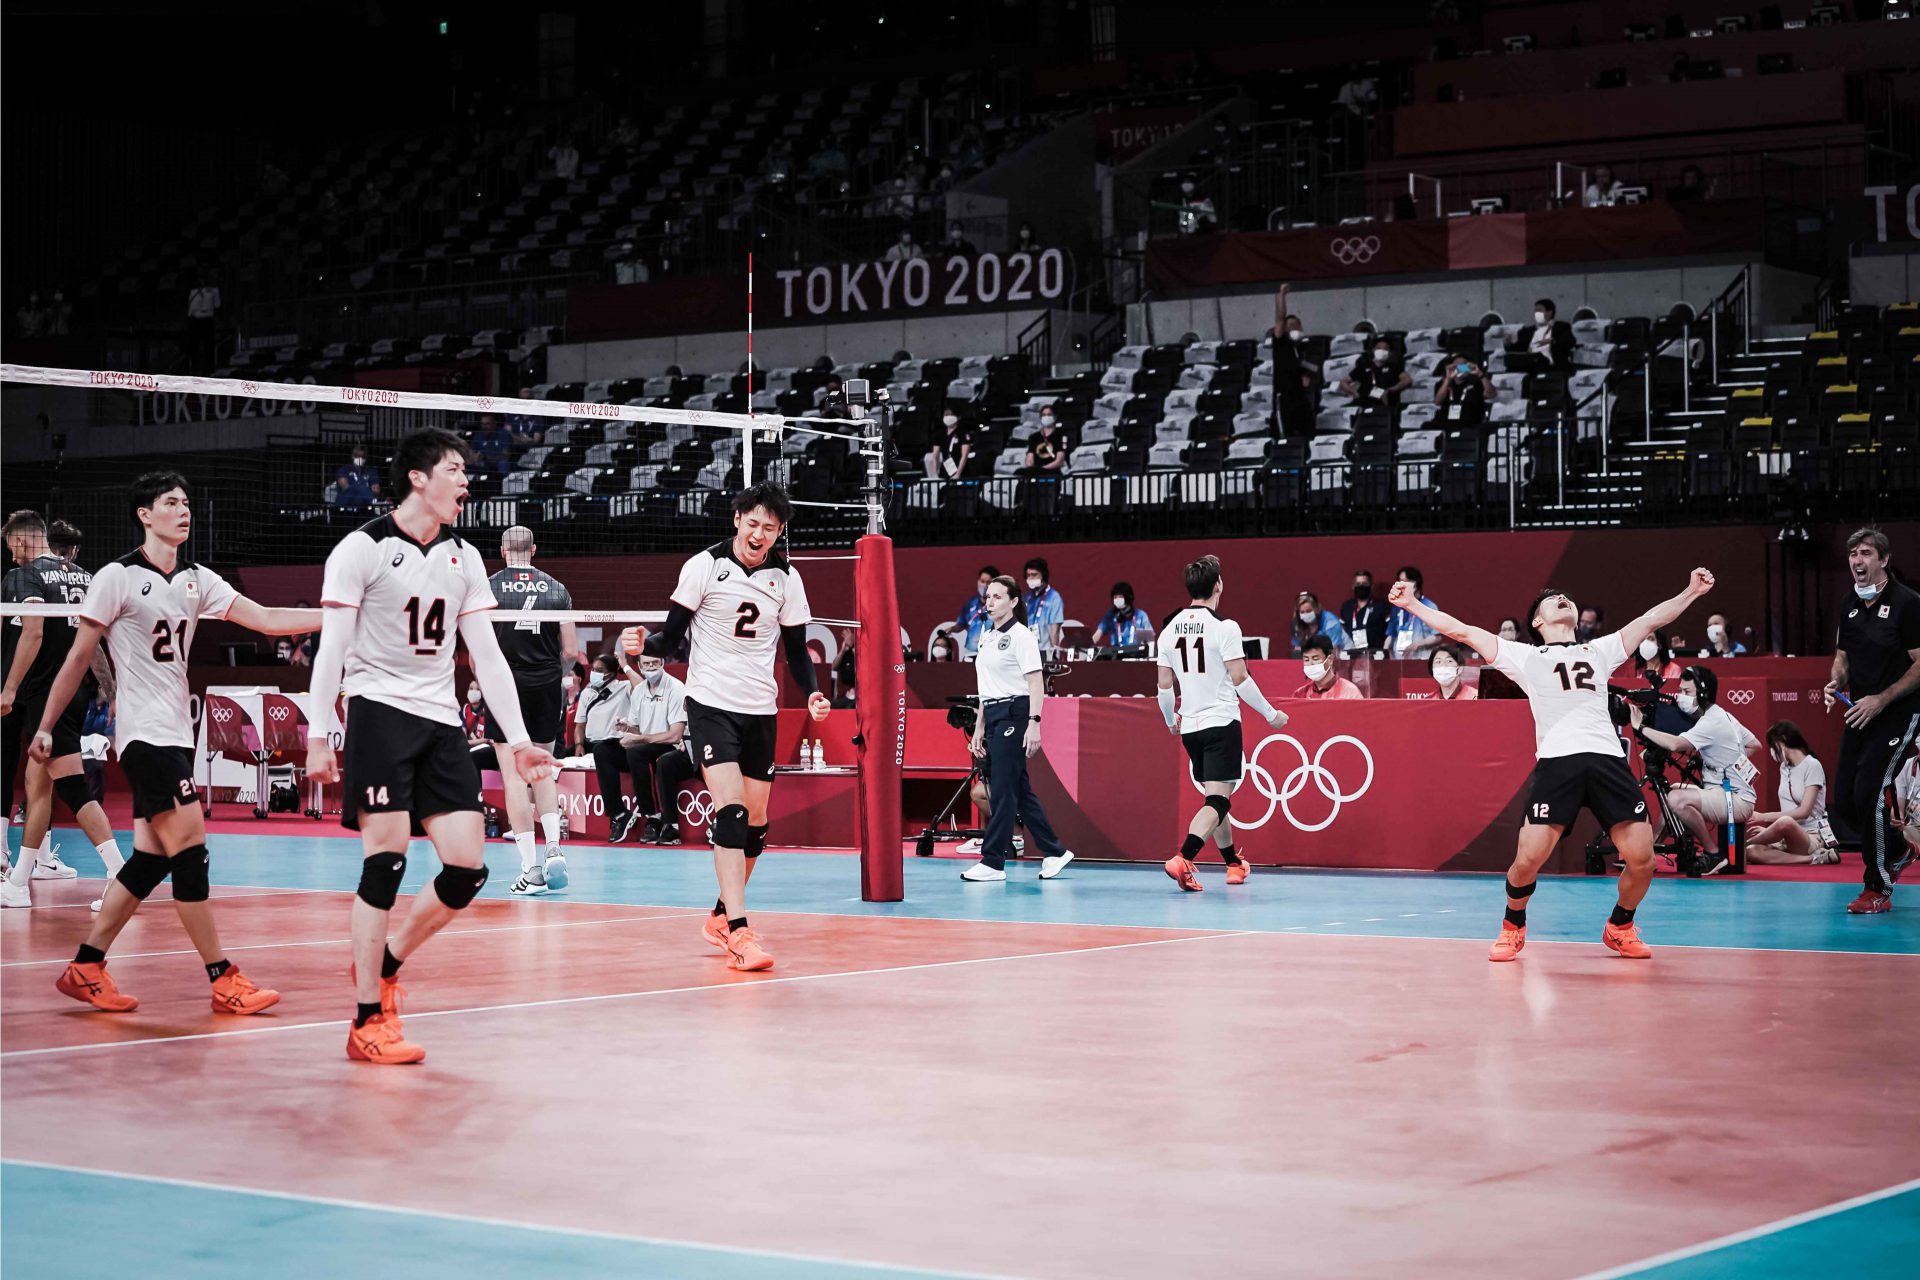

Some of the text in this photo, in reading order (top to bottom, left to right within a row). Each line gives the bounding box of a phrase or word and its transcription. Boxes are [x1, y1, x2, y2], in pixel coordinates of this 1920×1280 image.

[776, 248, 1064, 318] TOKYO 2020
[90, 371, 153, 389] TOKYO 2020
[342, 387, 399, 404] TOKYO 2020
[133, 390, 232, 427] TOKYO
[569, 403, 620, 417] TOKYO 2020
[501, 580, 549, 593] HOAG
[403, 596, 446, 647] 14
[733, 601, 761, 639] 2
[1174, 623, 1205, 635] NISHIDA
[152, 619, 188, 664] 21
[1174, 636, 1206, 674] 11
[1553, 661, 1597, 691] 12
[1772, 692, 1787, 702] TOKYO
[895, 689, 906, 766] TOKYO 2020
[703, 744, 714, 760] 2
[179, 777, 197, 797] 21
[366, 786, 390, 806] 14
[1532, 803, 1550, 818] 12
[211, 967, 220, 977] 21
